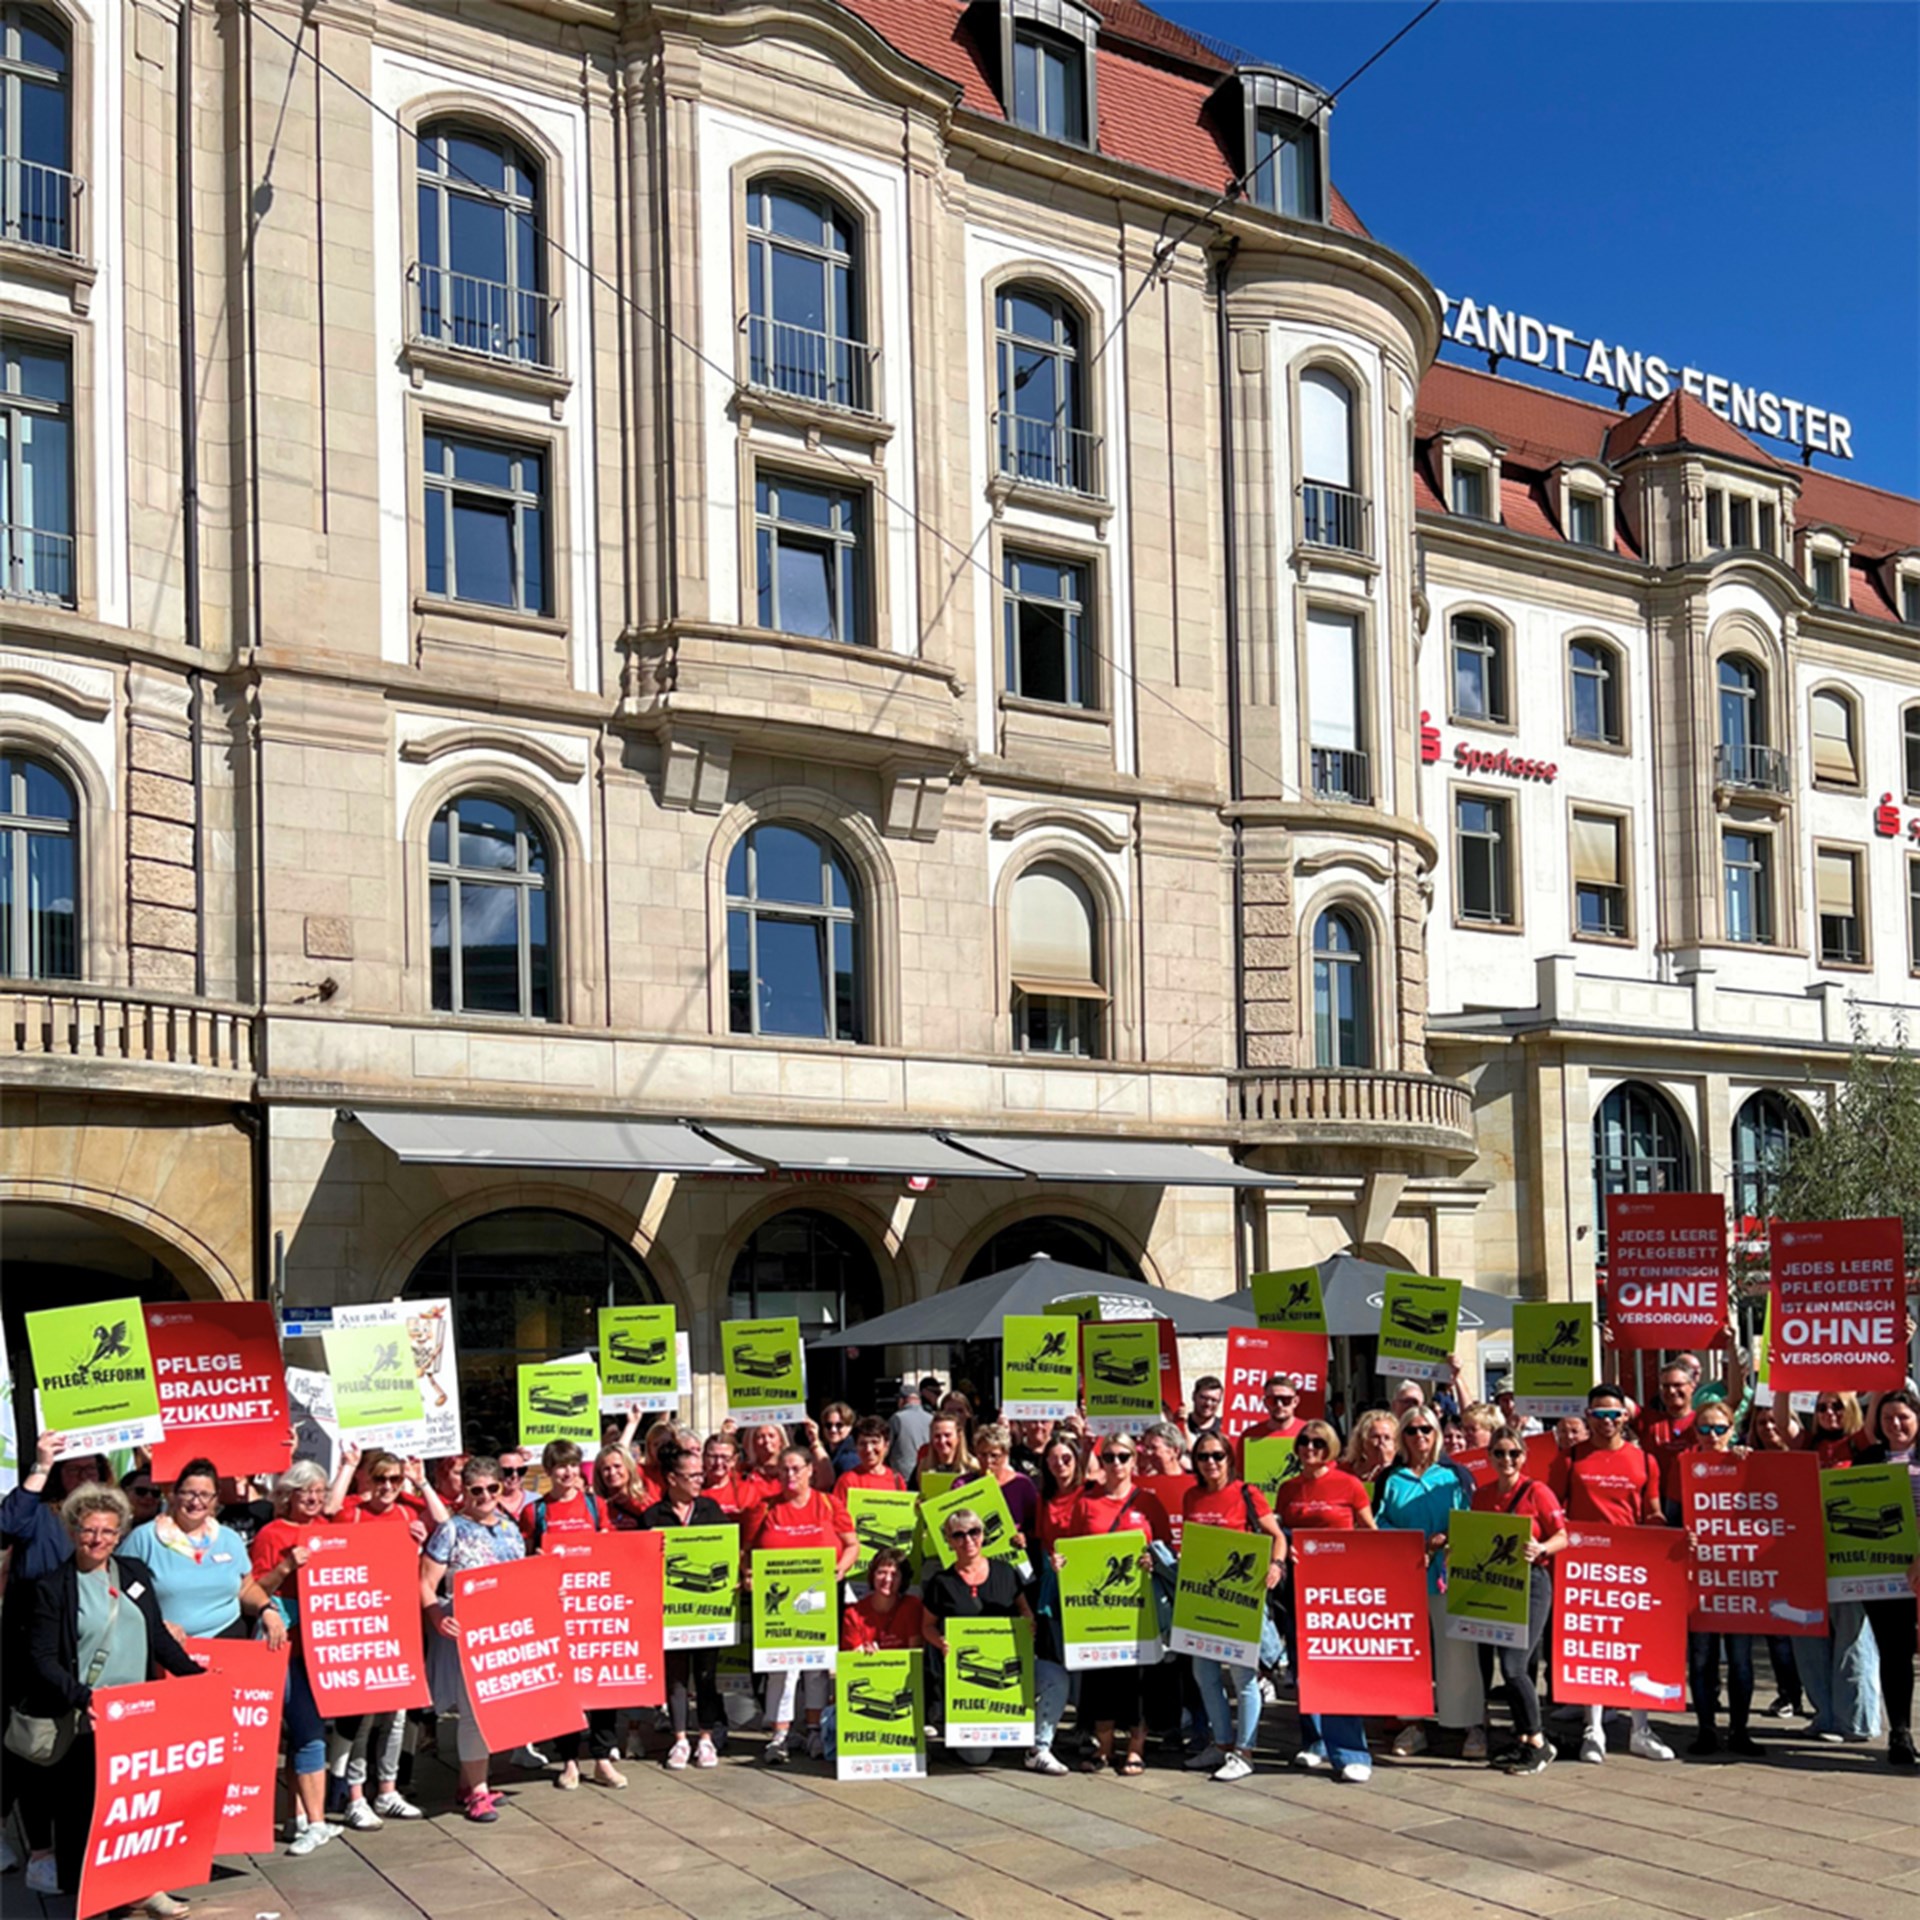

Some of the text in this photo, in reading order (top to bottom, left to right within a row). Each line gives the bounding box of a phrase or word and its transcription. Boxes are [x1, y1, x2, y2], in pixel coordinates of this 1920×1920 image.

[1585, 338, 1671, 402] ANS
[1682, 366, 1856, 460] FENSTER
[1454, 741, 1558, 785] Sparkasse
[1617, 1229, 1718, 1243] JEDES LEERE
[1617, 1246, 1718, 1260] PFLEGEBETT
[1617, 1266, 1719, 1278] IST EIN MENSCH
[1781, 1259, 1894, 1276] JEDES LEERE
[1619, 1282, 1717, 1307] OHNE
[1781, 1279, 1894, 1295] PFLEGEBETT
[1781, 1300, 1896, 1314] IST EIN MENSCH
[1617, 1314, 1718, 1326] VERSORGUNG.
[1781, 1319, 1895, 1346] OHNE
[157, 1354, 242, 1375] PFLEGE
[1781, 1351, 1895, 1365] VERSORGUNG.
[43, 1367, 146, 1392] PFLEGE REFORM
[159, 1375, 272, 1400] BRAUCHT
[162, 1399, 280, 1426] ZUKUNFT.
[1694, 1492, 1779, 1511] DIESES
[1695, 1518, 1796, 1537] PFLEGE-
[1697, 1544, 1759, 1563] BETT
[1829, 1550, 1865, 1565] PFLEGE
[308, 1565, 368, 1587] LEERE
[562, 1571, 611, 1590] EERE
[1565, 1561, 1648, 1584] DIESES
[1698, 1569, 1779, 1588] BLEIBT
[1180, 1580, 1215, 1598] PFLEGE
[1304, 1587, 1387, 1605] PFLEGE
[1564, 1587, 1662, 1611] PFLEGE-
[309, 1590, 392, 1613] PFLEGE-
[562, 1594, 634, 1613] FLEGE-
[1064, 1594, 1146, 1609] PFLEGE REFORM
[1699, 1594, 1765, 1614] LEER.
[311, 1615, 389, 1638] BETTEN
[564, 1617, 630, 1636] ETTEN
[1305, 1612, 1415, 1630] BRAUCHT
[1563, 1613, 1624, 1634] BETT
[466, 1617, 535, 1649] PFLEGE
[314, 1639, 401, 1663] TREFFEN
[470, 1636, 561, 1673] VERDIENT
[569, 1640, 639, 1660] REFFEN
[1307, 1637, 1422, 1656] ZUKUNFT.
[1562, 1638, 1642, 1661] BLEIBT
[318, 1663, 416, 1689] UNS ALLE.
[475, 1662, 563, 1699] RESPEKT.
[597, 1663, 653, 1683] ALLE.
[1562, 1664, 1626, 1688] LEER.
[244, 1689, 274, 1701] VON:
[952, 1698, 1027, 1717] PFLEGE REFORM
[844, 1731, 876, 1744] PFLEGE
[109, 1736, 225, 1786] PFLEGE
[241, 1785, 261, 1797] zur
[103, 1788, 162, 1827] AM
[95, 1820, 188, 1867] LIMIT.
